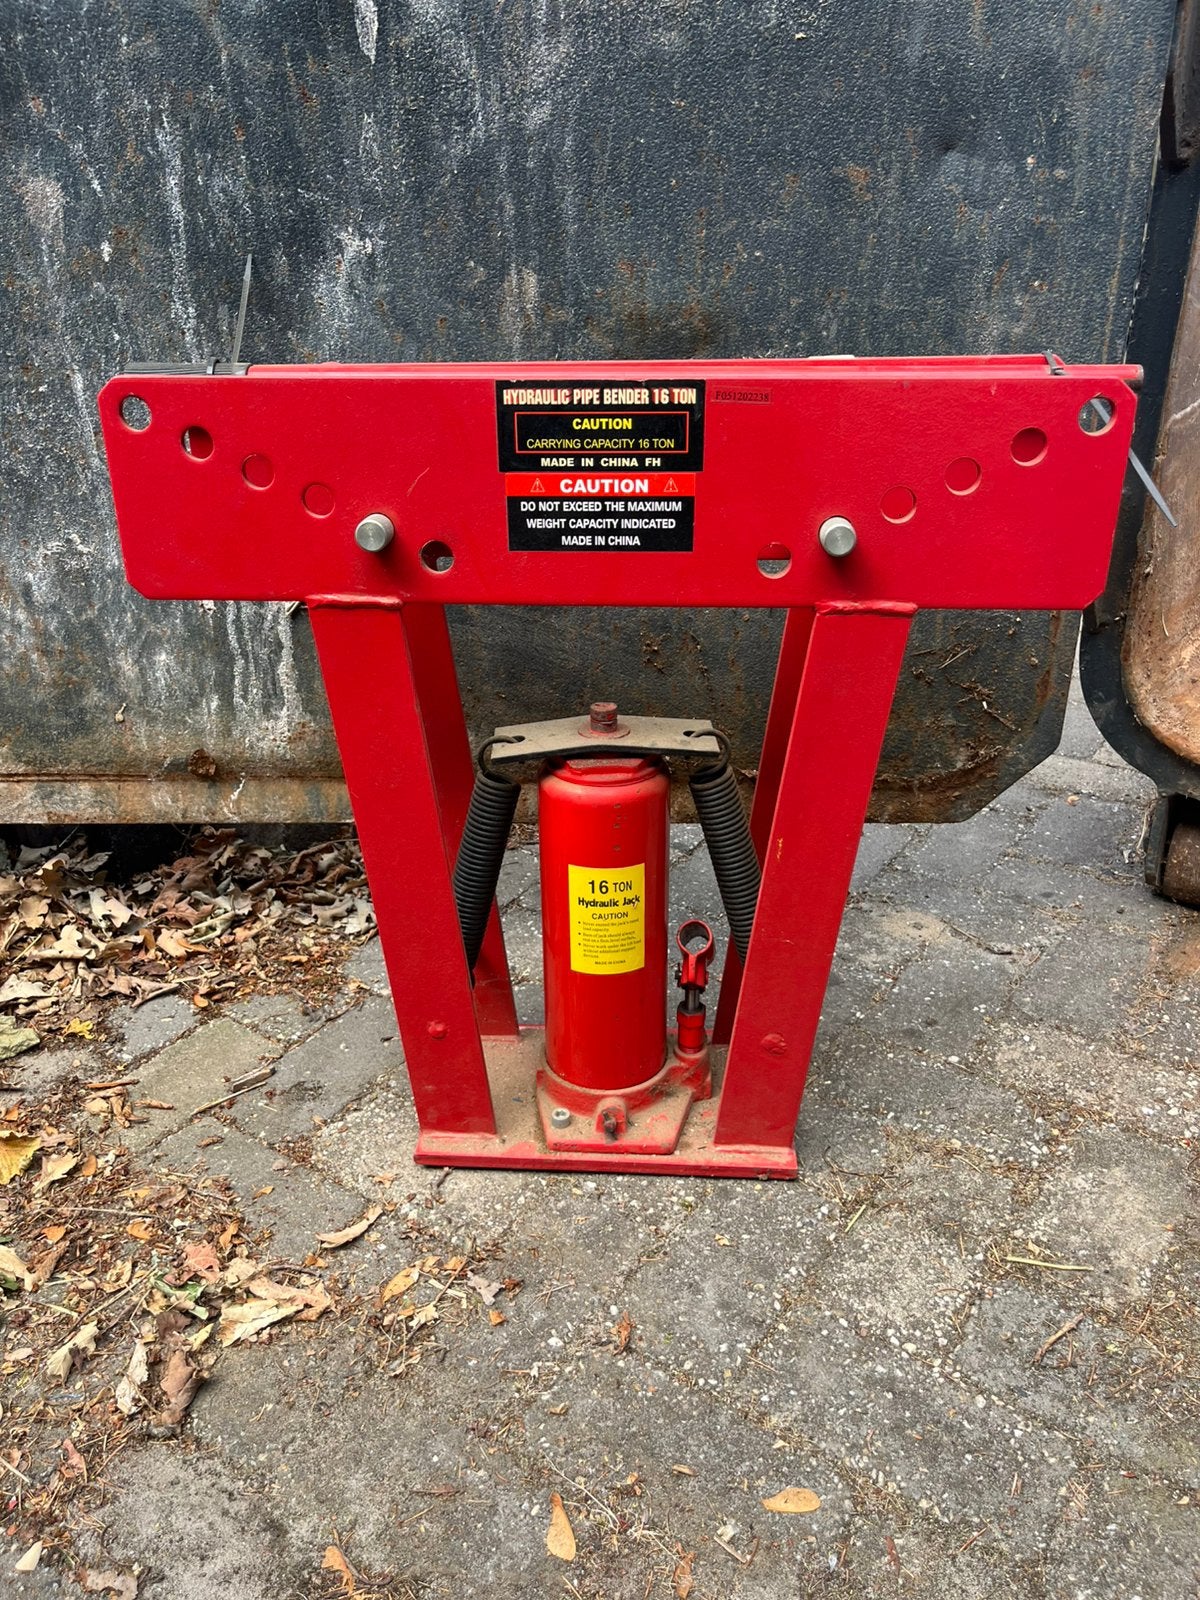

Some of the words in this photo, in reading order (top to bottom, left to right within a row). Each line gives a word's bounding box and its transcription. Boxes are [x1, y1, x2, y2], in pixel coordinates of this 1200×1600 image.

[503, 388, 571, 405] HYDRAULIC
[572, 388, 600, 405] PIPE
[603, 388, 650, 405] BENDER
[653, 387, 670, 404] 16
[672, 387, 697, 405] TON
[715, 390, 770, 402] F051202238
[572, 418, 632, 430] CAUTION
[526, 439, 581, 449] CARRYING
[583, 439, 635, 449] CAPACITY
[638, 438, 650, 449] 16
[652, 438, 675, 449] TON
[540, 458, 575, 467] MADE
[581, 458, 594, 467] IN
[600, 458, 639, 467] CHINA
[645, 458, 661, 467] FH
[559, 478, 649, 494] CAUTION
[520, 501, 536, 512] DO
[538, 501, 560, 512] NOT
[562, 501, 602, 512] EXCEED
[604, 501, 625, 512] THE
[627, 501, 682, 512] MAXIMUM
[526, 518, 566, 529] WEIGHT
[568, 518, 619, 529] CAPACITY
[621, 518, 676, 529] INDICATED
[561, 535, 592, 546] MADE
[594, 535, 606, 546] IN
[608, 535, 641, 546] CHINA
[588, 880, 609, 894] 16
[613, 880, 632, 892] TON
[578, 896, 619, 908] Hydraulic
[622, 894, 640, 906] Jack
[592, 912, 628, 920] CAUTION
